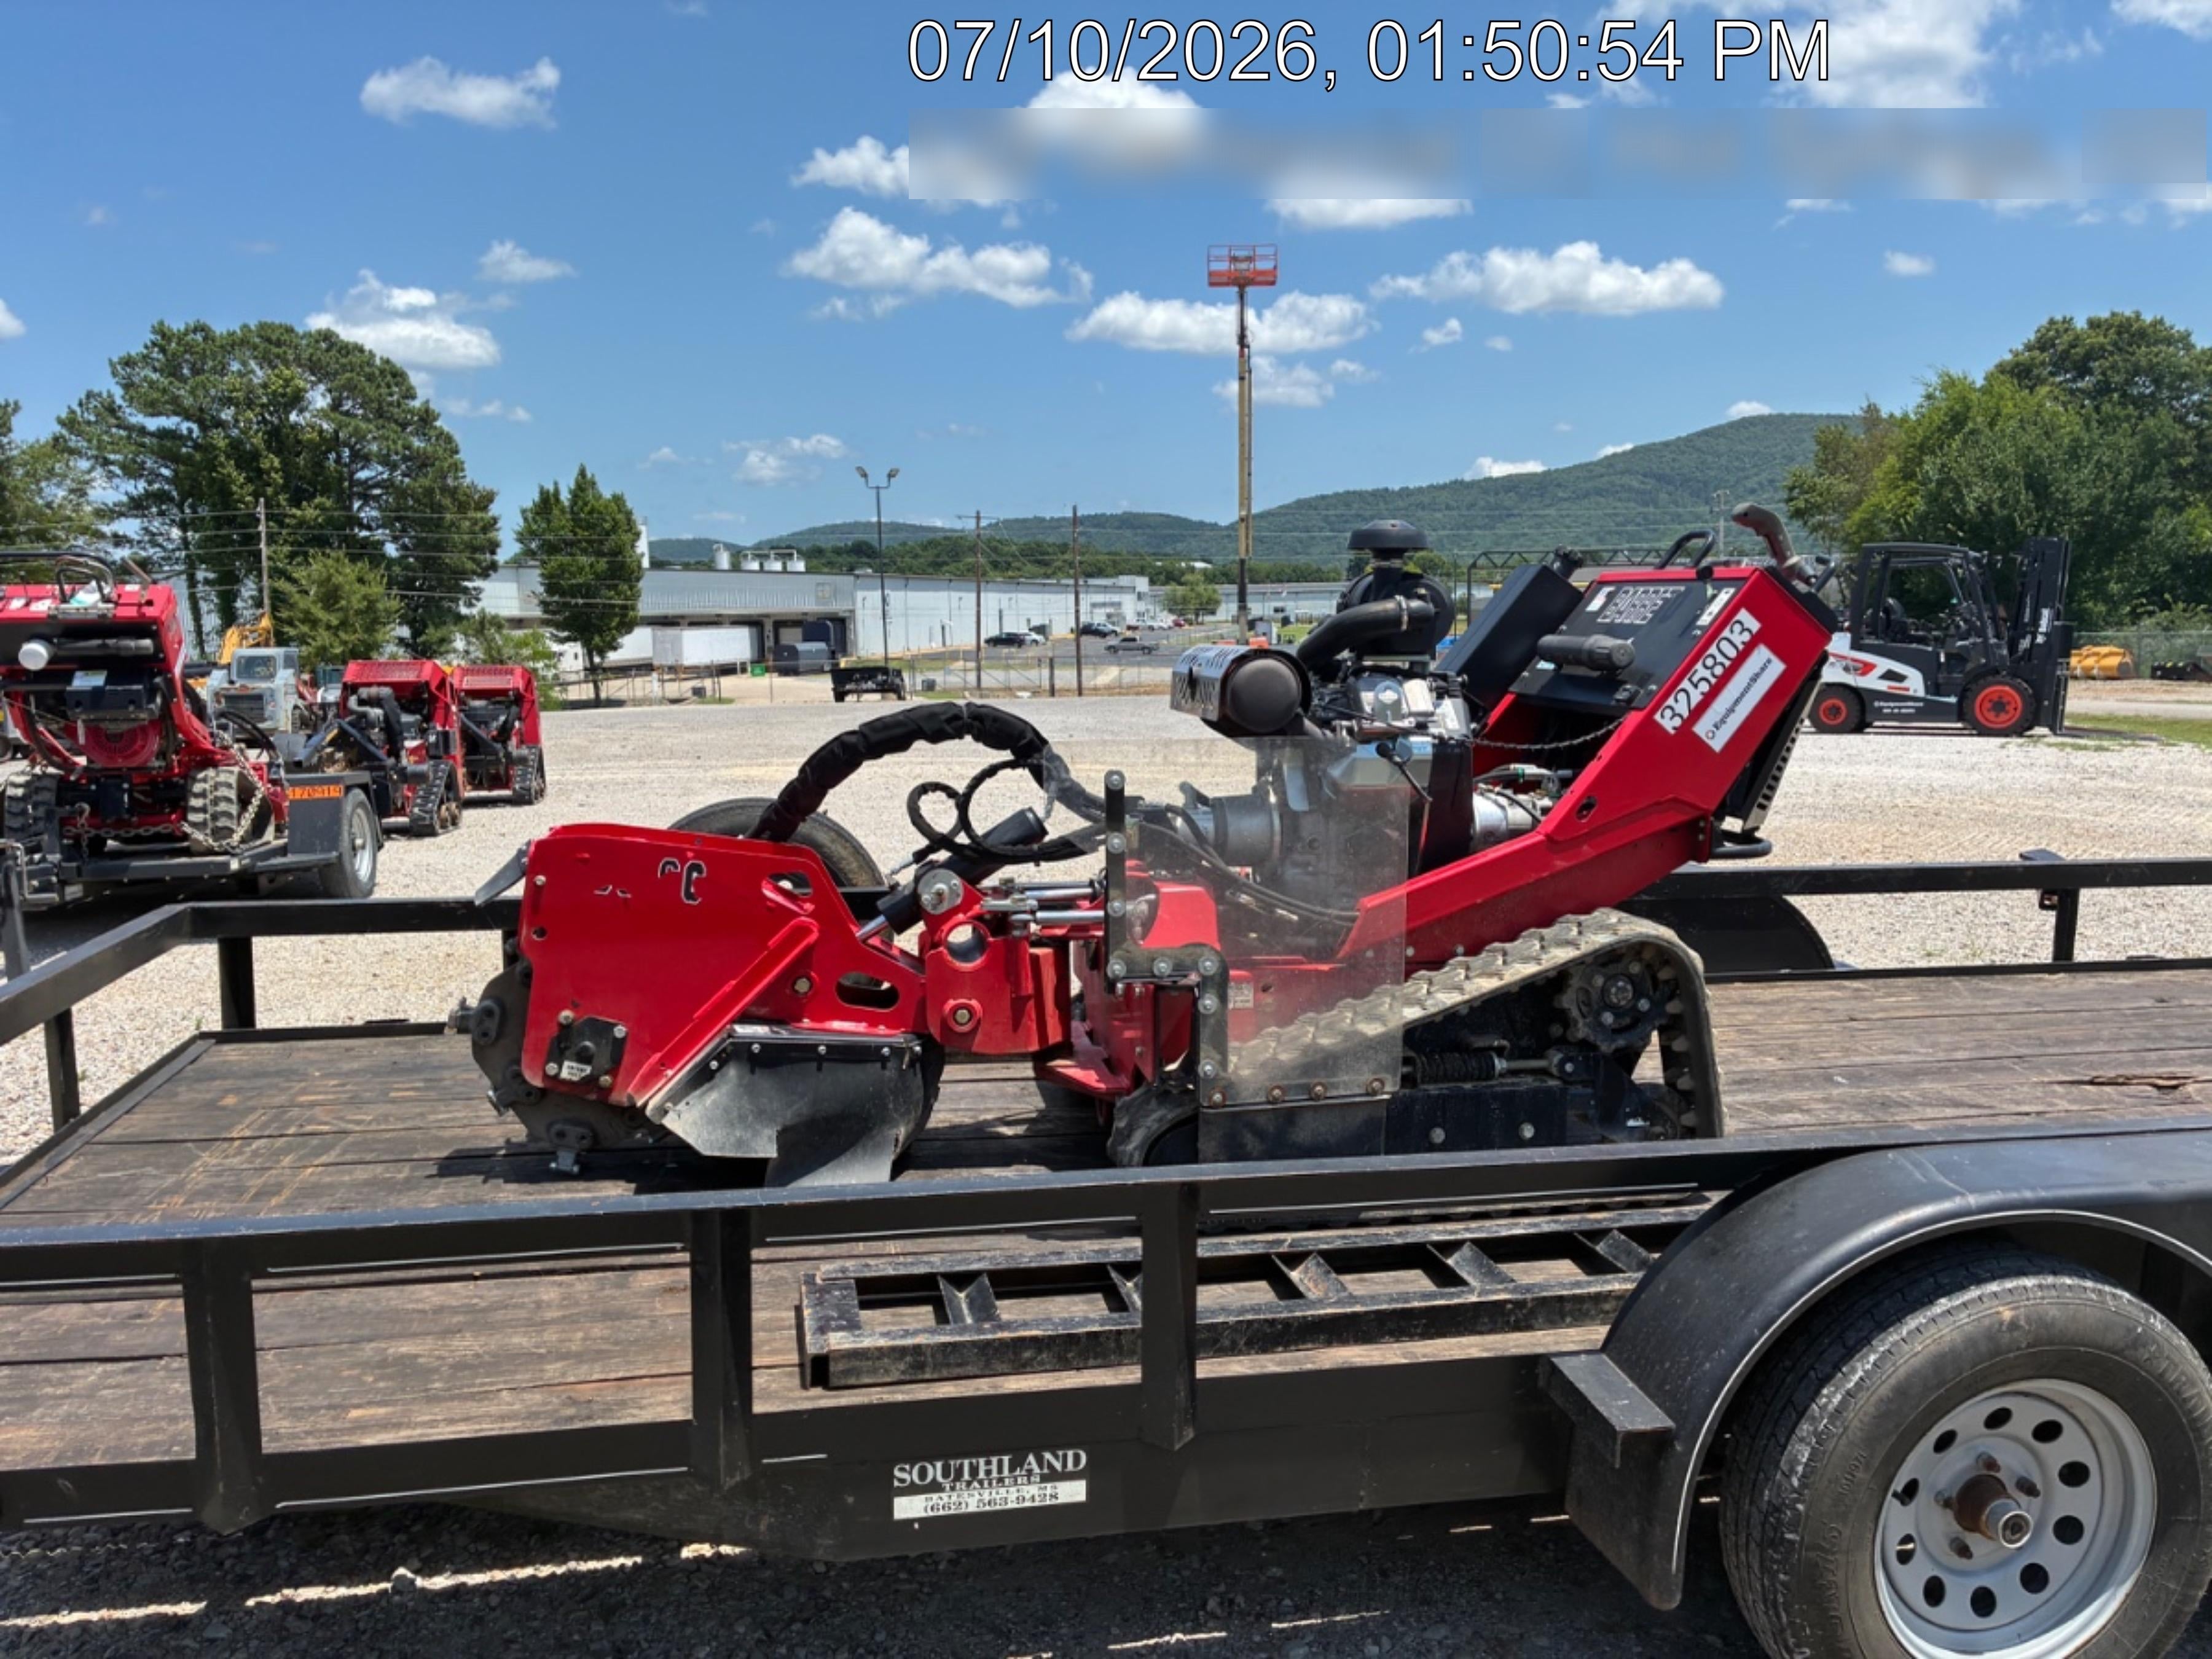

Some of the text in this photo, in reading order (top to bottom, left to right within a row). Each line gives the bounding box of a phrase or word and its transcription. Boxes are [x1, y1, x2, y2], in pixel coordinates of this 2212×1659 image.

[1660, 619, 1753, 731] 325803
[1712, 657, 1773, 731] EquipmentShare
[893, 1449, 1087, 1488] SOUTHLAND
[941, 1474, 1041, 1493] TRAILERS
[924, 1500, 970, 1515] (662)
